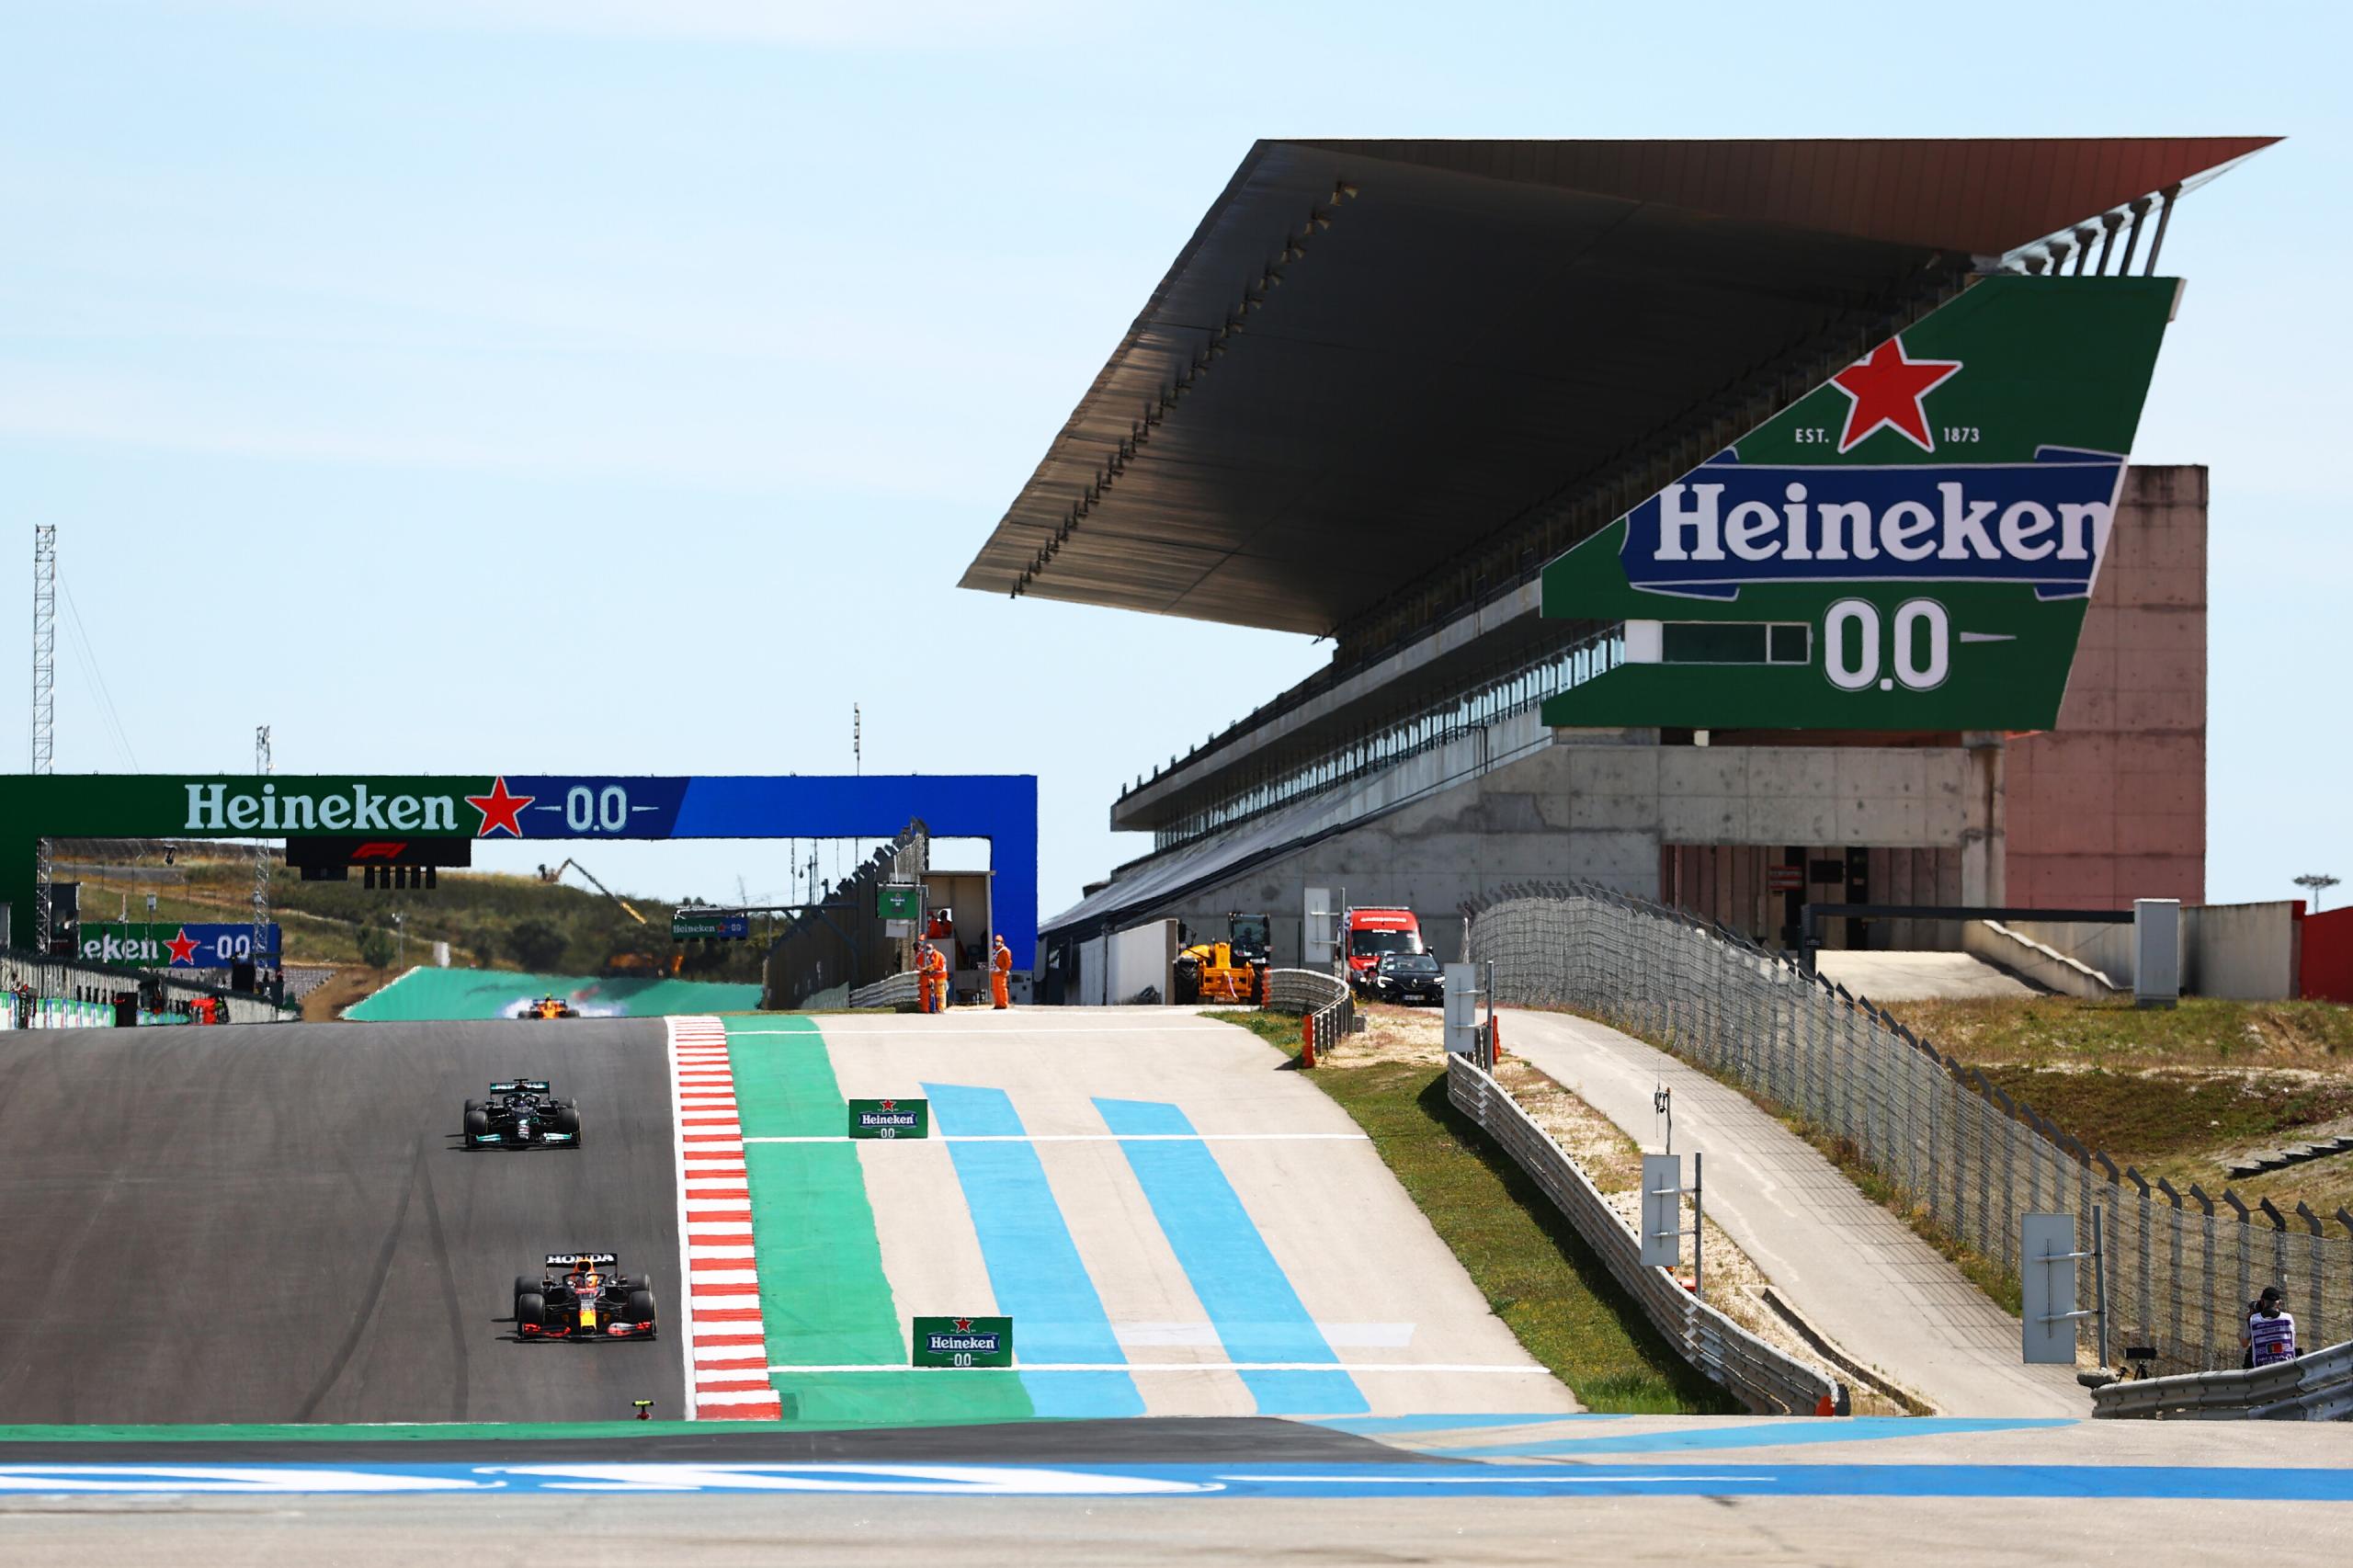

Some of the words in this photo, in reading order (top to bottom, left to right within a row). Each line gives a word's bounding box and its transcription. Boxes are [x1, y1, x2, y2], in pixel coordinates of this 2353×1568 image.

[1795, 428, 1829, 443] EST.
[1943, 427, 1980, 442] 1873
[1654, 483, 2112, 562] Heineken
[1824, 599, 1949, 690] 0.0
[185, 783, 458, 830] Heineken
[566, 786, 627, 832] 0.0
[79, 933, 159, 960] eken
[862, 1113, 914, 1124] Heineken
[931, 1335, 995, 1349] Heineken
